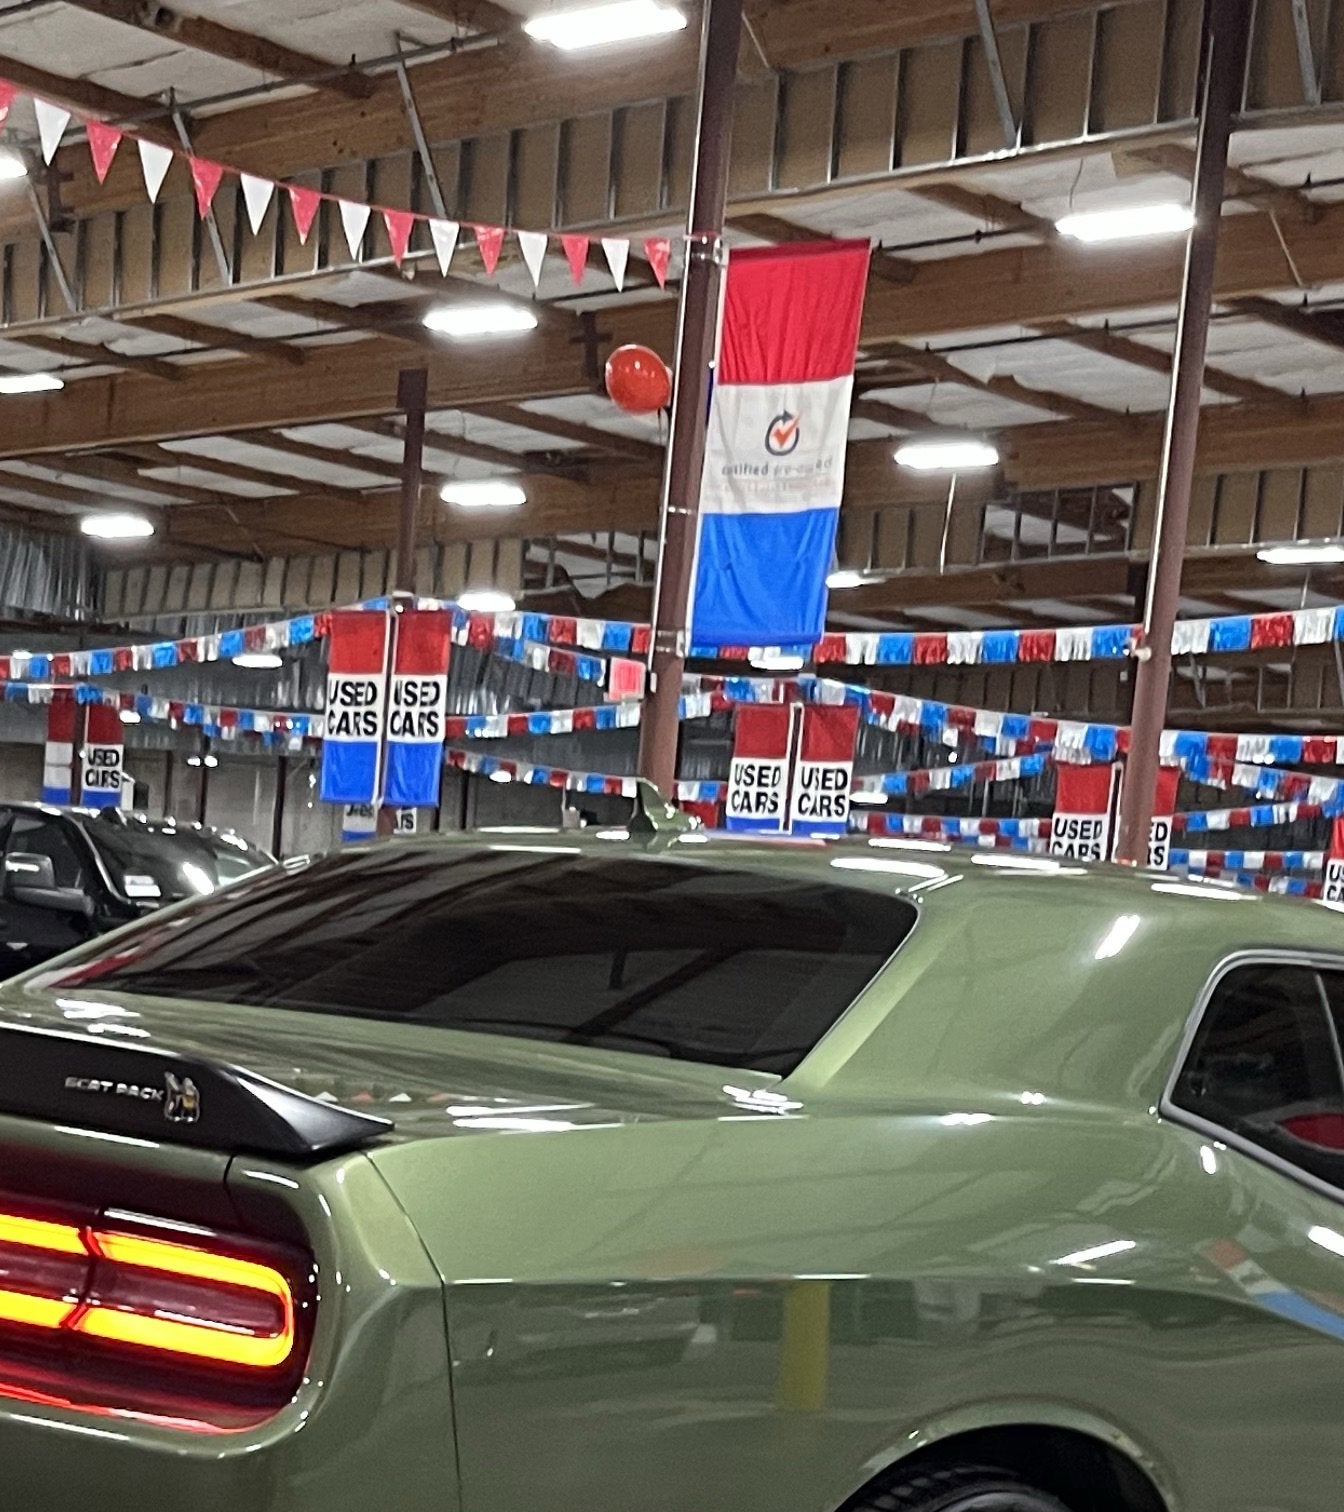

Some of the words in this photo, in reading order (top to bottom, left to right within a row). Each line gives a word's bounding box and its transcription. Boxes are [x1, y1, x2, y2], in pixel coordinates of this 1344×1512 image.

[328, 679, 378, 706] USED
[394, 680, 441, 706] USED
[327, 709, 378, 736] CARS
[390, 710, 439, 737] CARS
[733, 763, 782, 788] USED
[800, 766, 849, 791] USED
[731, 790, 780, 815] CARS
[797, 792, 847, 818] CARS
[1053, 817, 1103, 840] USED
[116, 1083, 165, 1100] PACK
